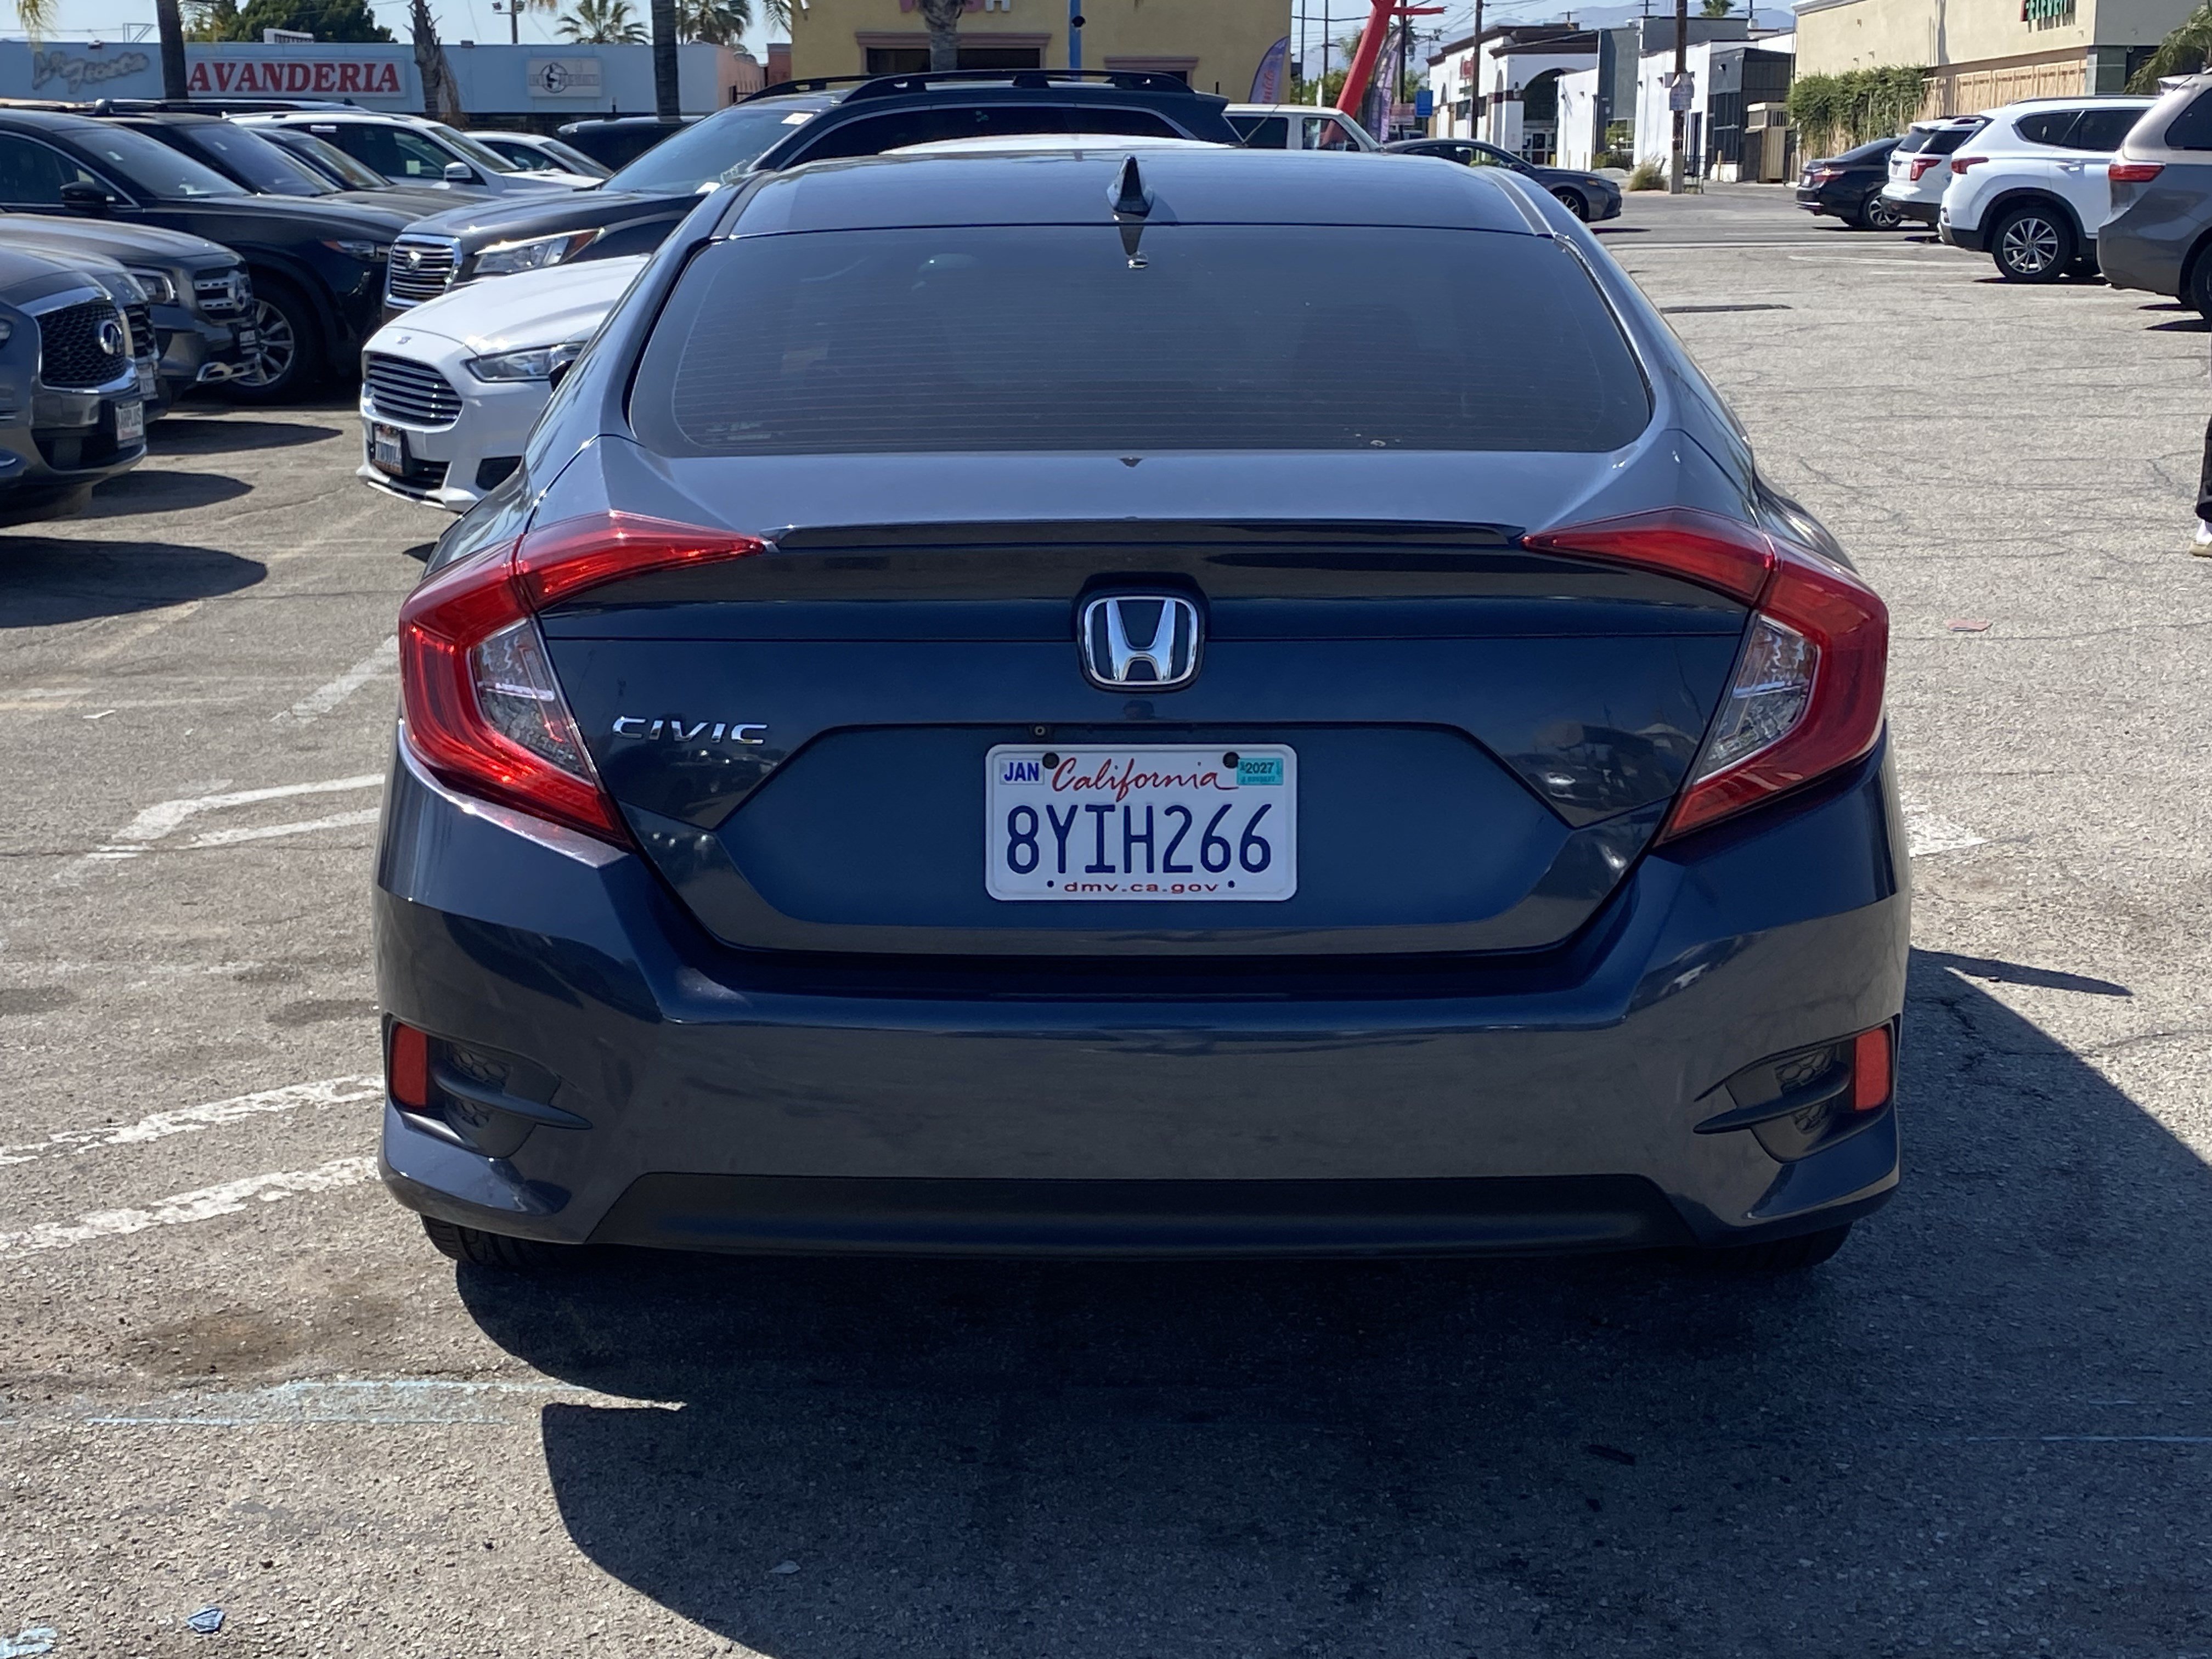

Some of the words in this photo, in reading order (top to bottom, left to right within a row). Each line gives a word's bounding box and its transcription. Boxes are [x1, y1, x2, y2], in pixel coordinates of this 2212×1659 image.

[612, 716, 768, 744] CIVIC
[1004, 762, 1040, 782] JAN
[1052, 757, 1239, 802] California
[1245, 762, 1275, 774] 2027
[1007, 804, 1272, 874] 8YIH266
[1064, 882, 1219, 893] dmv.ca.gov
